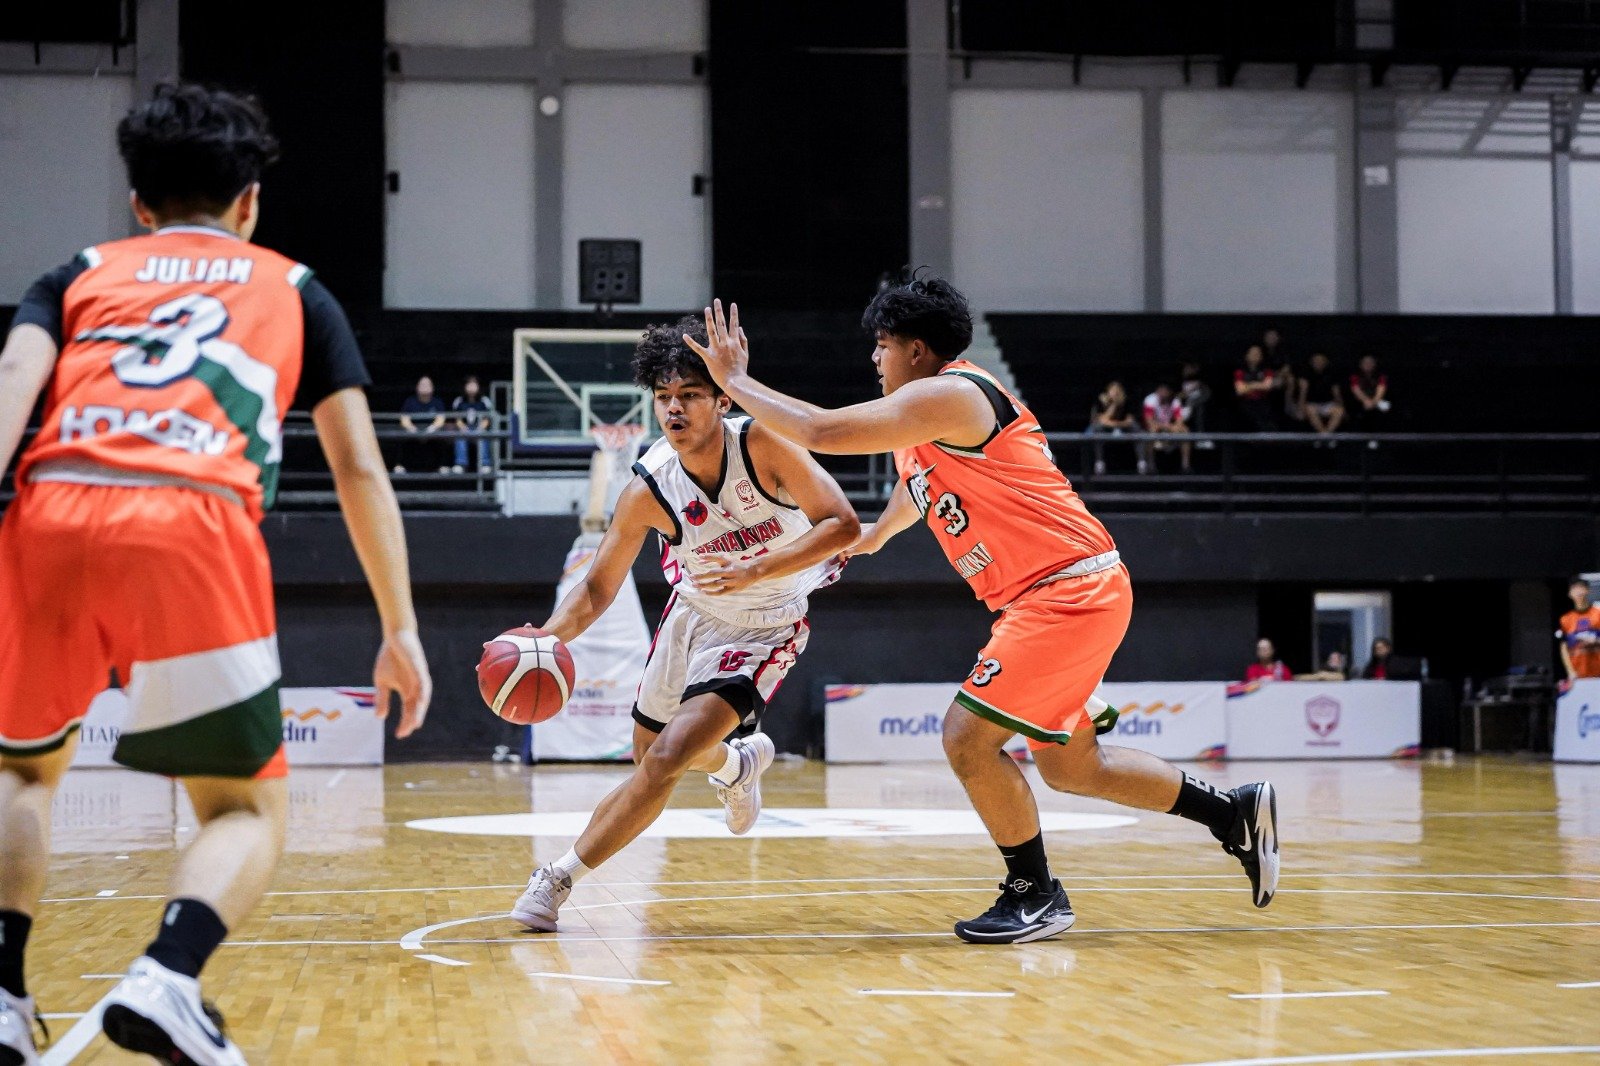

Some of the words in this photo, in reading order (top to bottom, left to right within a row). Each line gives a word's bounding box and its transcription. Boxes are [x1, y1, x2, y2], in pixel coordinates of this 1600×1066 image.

[136, 257, 253, 283] JULIAN
[110, 294, 231, 388] 3
[282, 720, 317, 742] diri
[880, 713, 944, 735] molt
